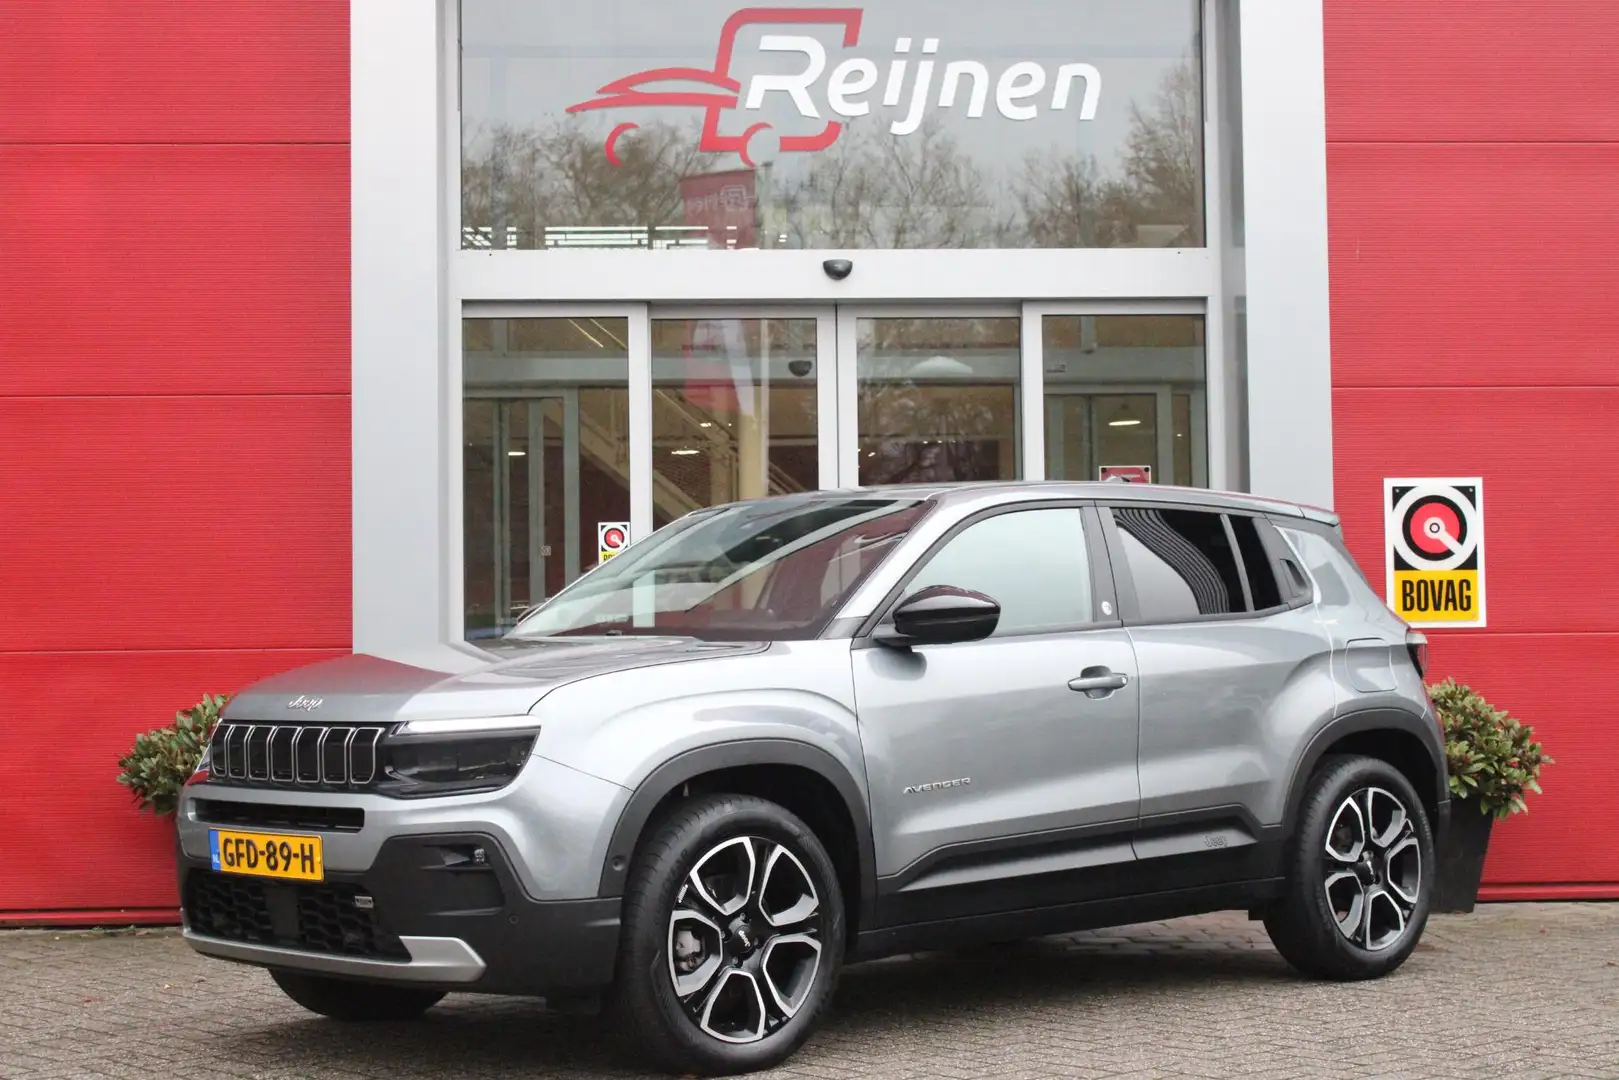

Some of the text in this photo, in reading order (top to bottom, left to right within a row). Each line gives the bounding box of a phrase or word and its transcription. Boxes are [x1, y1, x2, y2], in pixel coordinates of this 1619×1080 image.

[744, 35, 1102, 135] Reijnen
[1402, 578, 1472, 612] BOVAG
[903, 777, 971, 794] AVENGER
[223, 837, 315, 874] GFD-89-H
